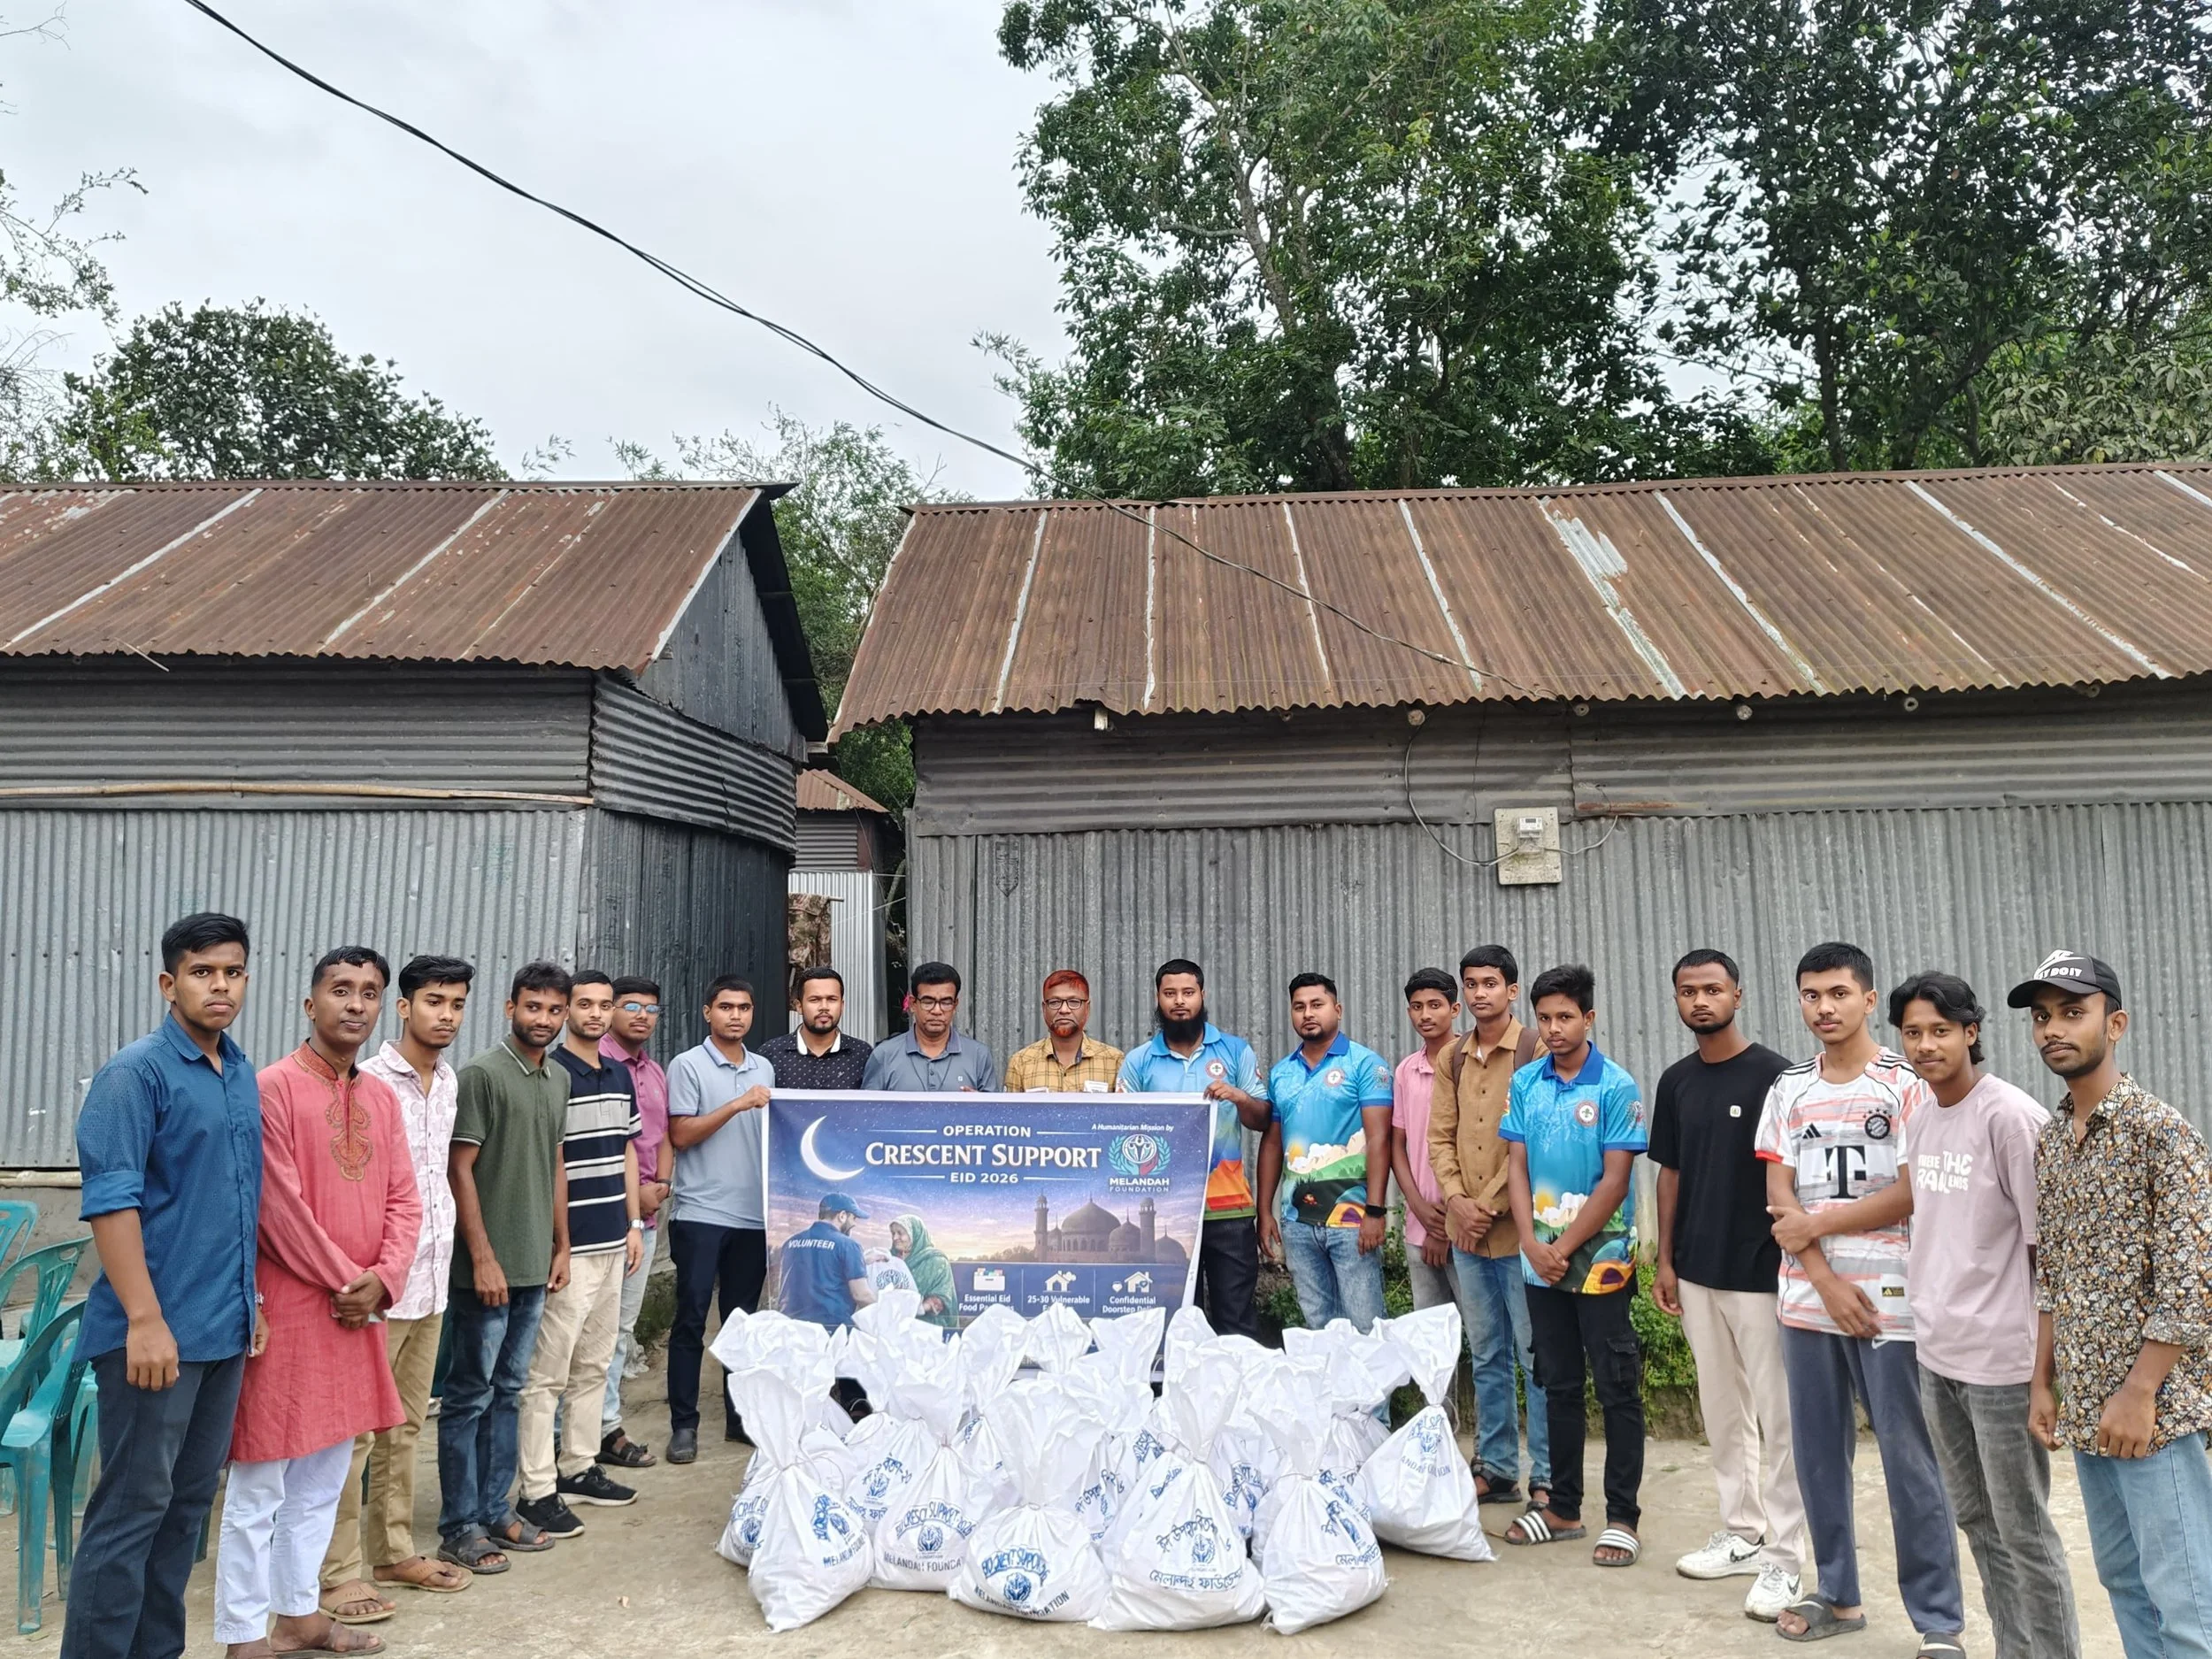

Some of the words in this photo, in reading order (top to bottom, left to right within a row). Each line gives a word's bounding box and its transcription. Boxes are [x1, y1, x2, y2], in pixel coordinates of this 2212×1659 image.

[943, 1125, 1031, 1137] OPERATION
[1164, 1124, 1174, 1133] by
[865, 1141, 987, 1166] CRESCENT
[991, 1143, 1102, 1168] SUPPORT
[1942, 1150, 1973, 1176] THE
[950, 1172, 976, 1183] EID
[979, 1173, 1018, 1184] 2026
[788, 1239, 835, 1250] VOLUNTEER
[964, 1294, 997, 1302] Essential
[1102, 1305, 1135, 1314] Doorstep
[926, 1557, 964, 1572] FOUNDA
